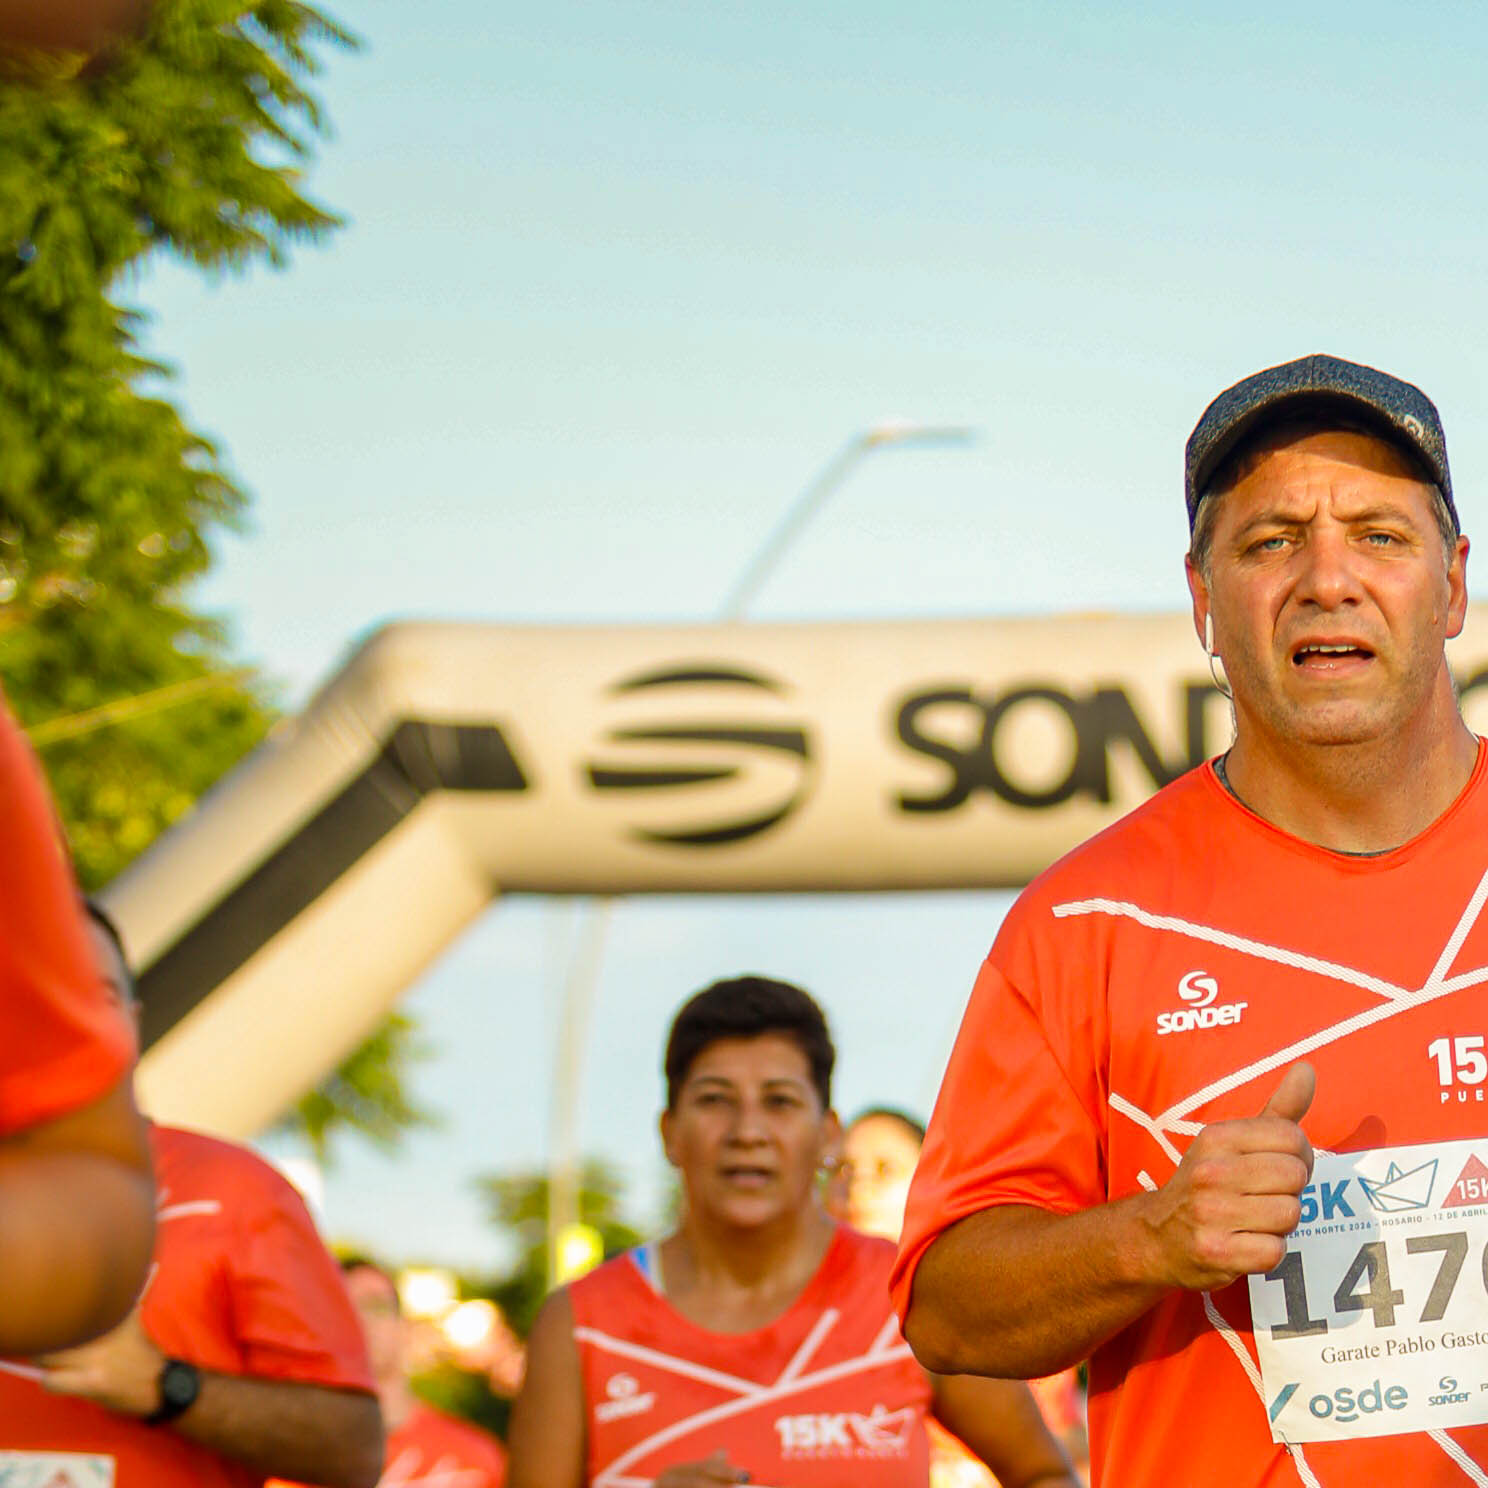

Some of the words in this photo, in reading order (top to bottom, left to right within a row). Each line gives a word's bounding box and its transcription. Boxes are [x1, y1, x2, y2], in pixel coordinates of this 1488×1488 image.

[1299, 1179, 1356, 1224] 5K
[1286, 1228, 1312, 1239] ERTO
[1315, 1224, 1346, 1236] NORTE
[1349, 1221, 1372, 1231] 2026
[1382, 1215, 1423, 1227] ROSARIO
[1446, 1211, 1458, 1220] DE
[1462, 1208, 1488, 1218] ABRIL
[1321, 1346, 1380, 1365] Garate
[1386, 1335, 1436, 1357] Pablo
[1309, 1379, 1409, 1420] osde
[773, 1412, 851, 1447] 15K
